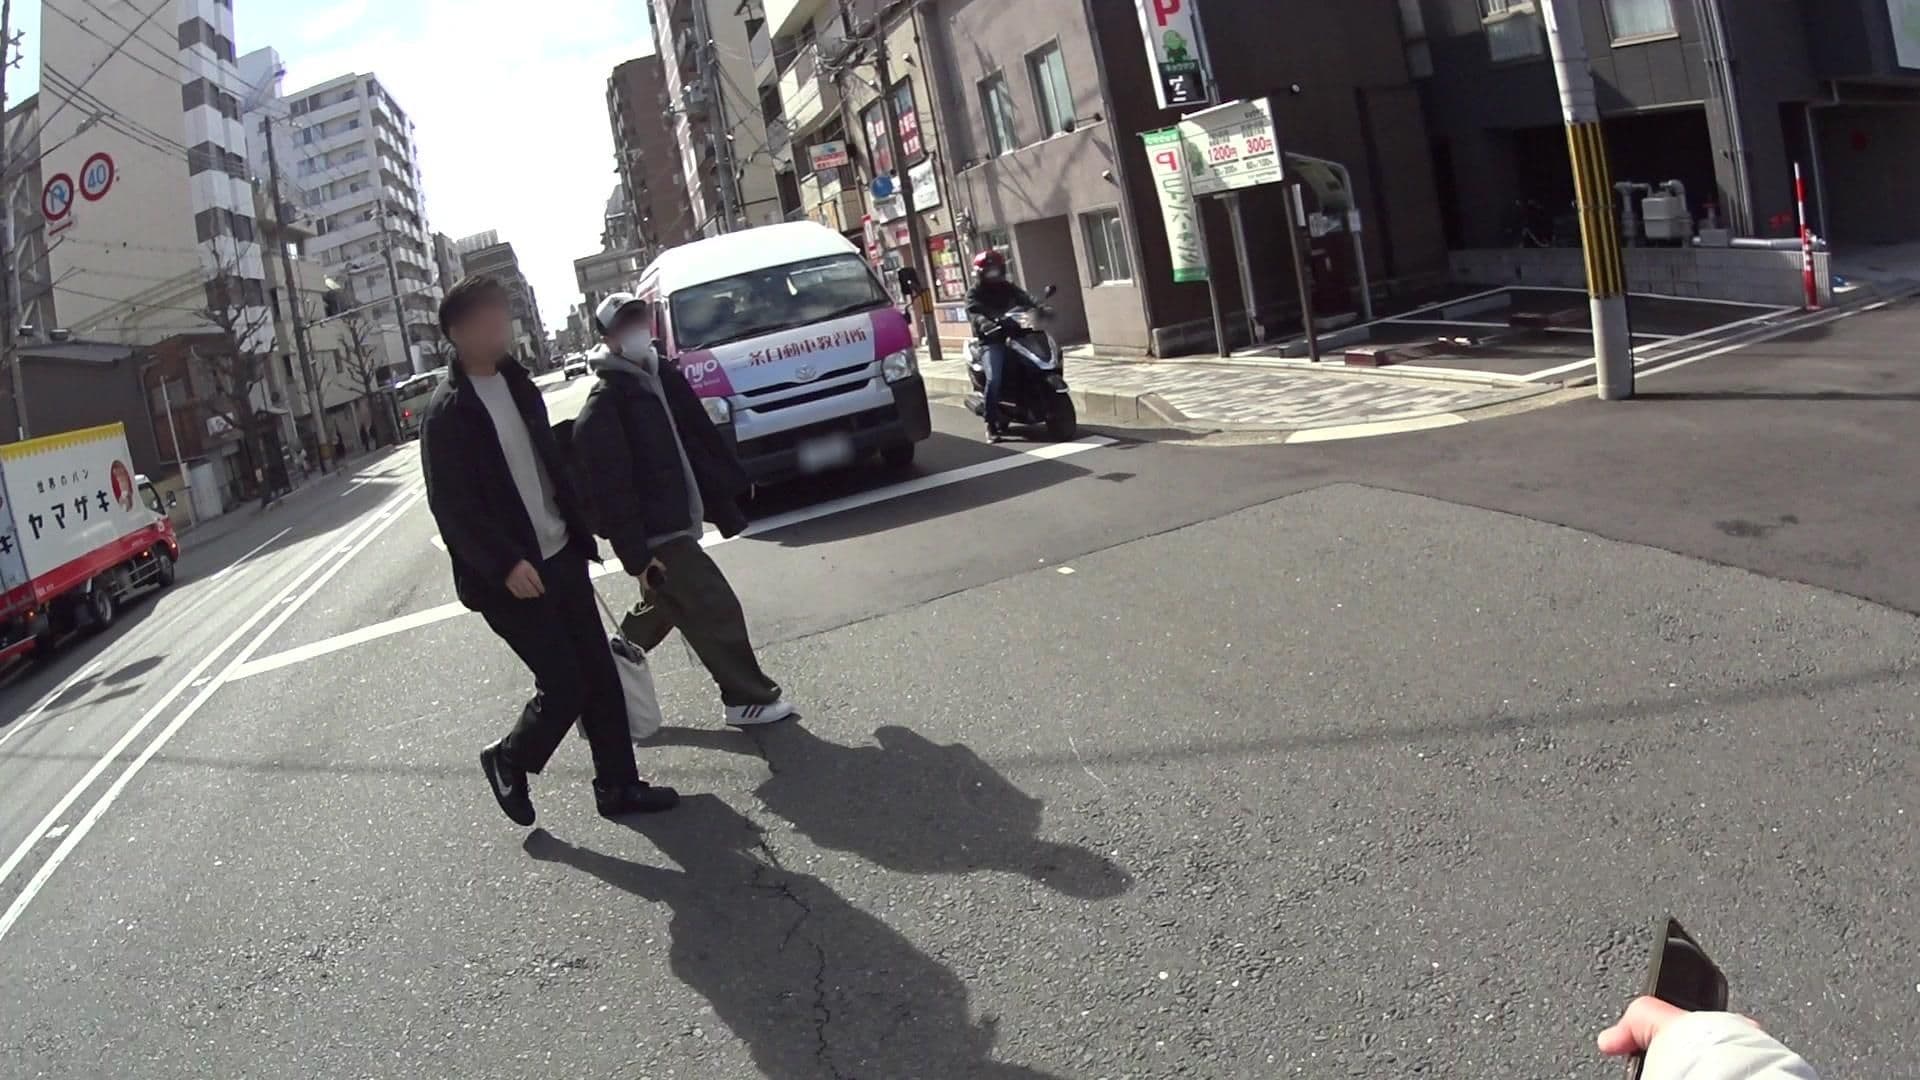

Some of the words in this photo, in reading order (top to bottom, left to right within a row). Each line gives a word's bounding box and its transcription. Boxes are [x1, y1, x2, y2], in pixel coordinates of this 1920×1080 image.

[1153, 0, 1181, 26] P
[1208, 144, 1238, 162] 1200円
[1246, 136, 1272, 154] 300円
[87, 163, 106, 188] 40
[36, 468, 89, 494] 世界のパン
[28, 490, 110, 540] ヤマザキ
